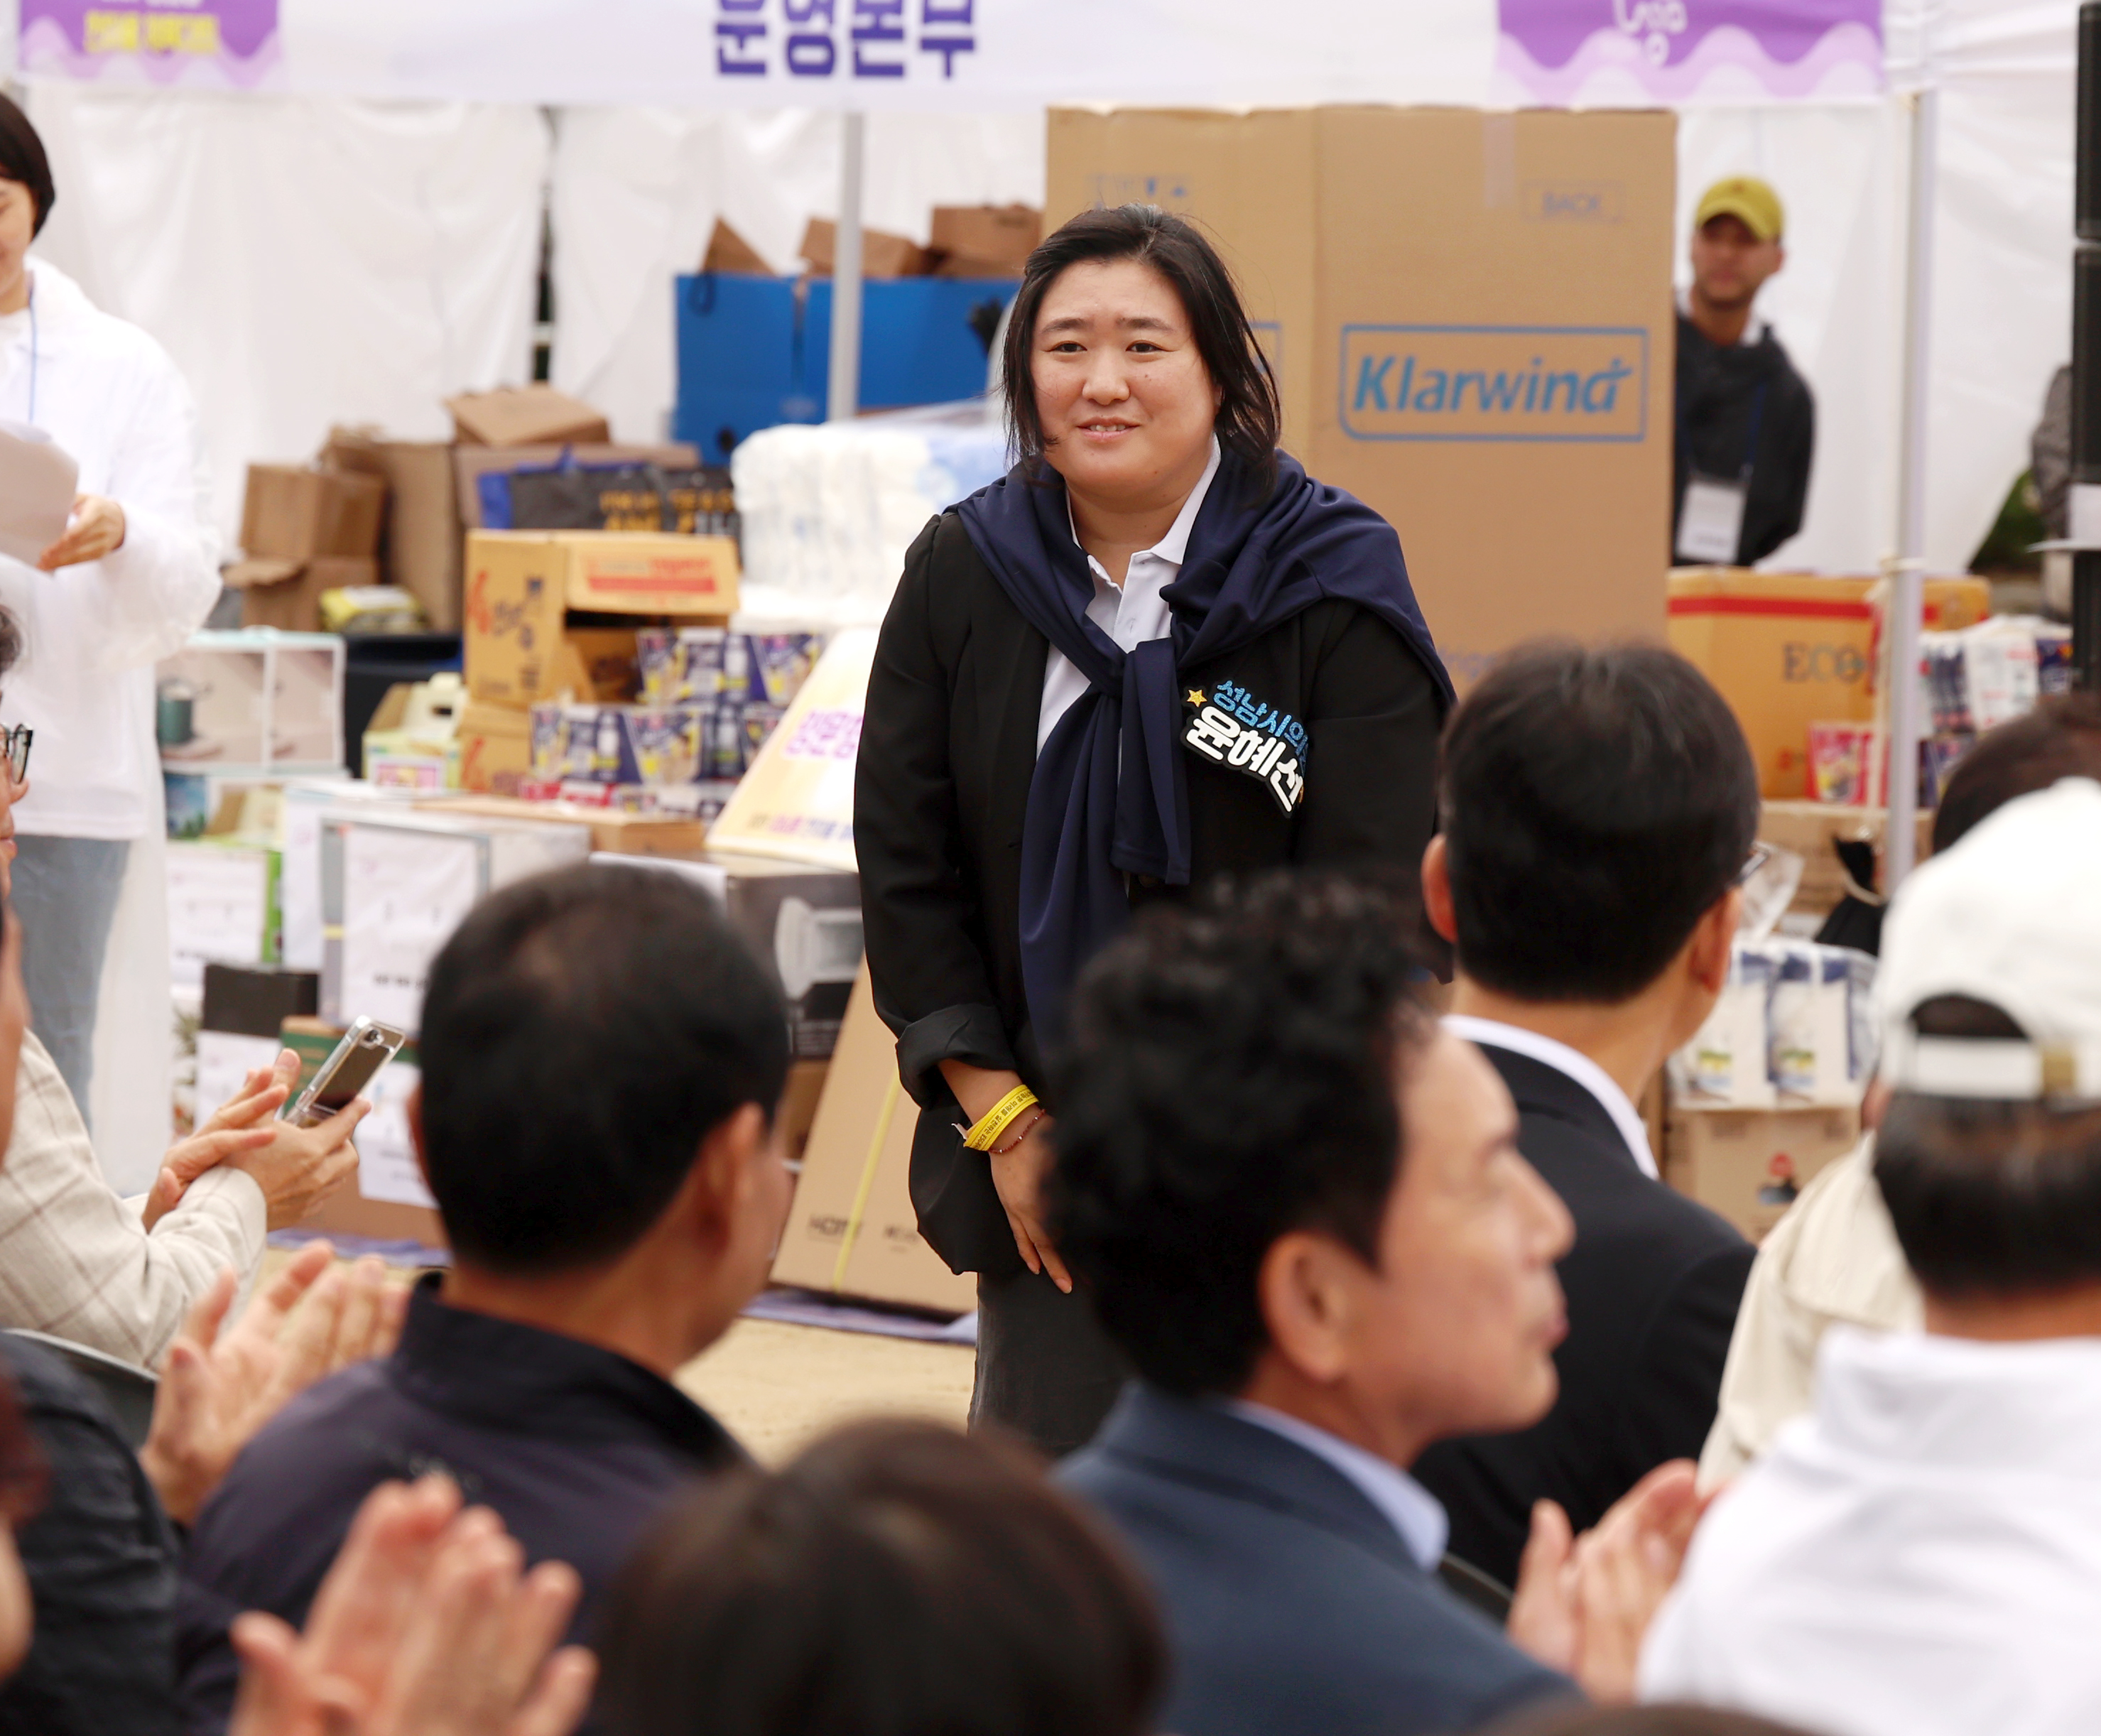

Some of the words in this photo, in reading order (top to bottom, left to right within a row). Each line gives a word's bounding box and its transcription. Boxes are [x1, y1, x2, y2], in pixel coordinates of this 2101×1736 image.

[715, 0, 975, 78] 운영본부
[1353, 355, 1632, 413] Klarwind
[1186, 706, 1303, 812] 윤혜선
